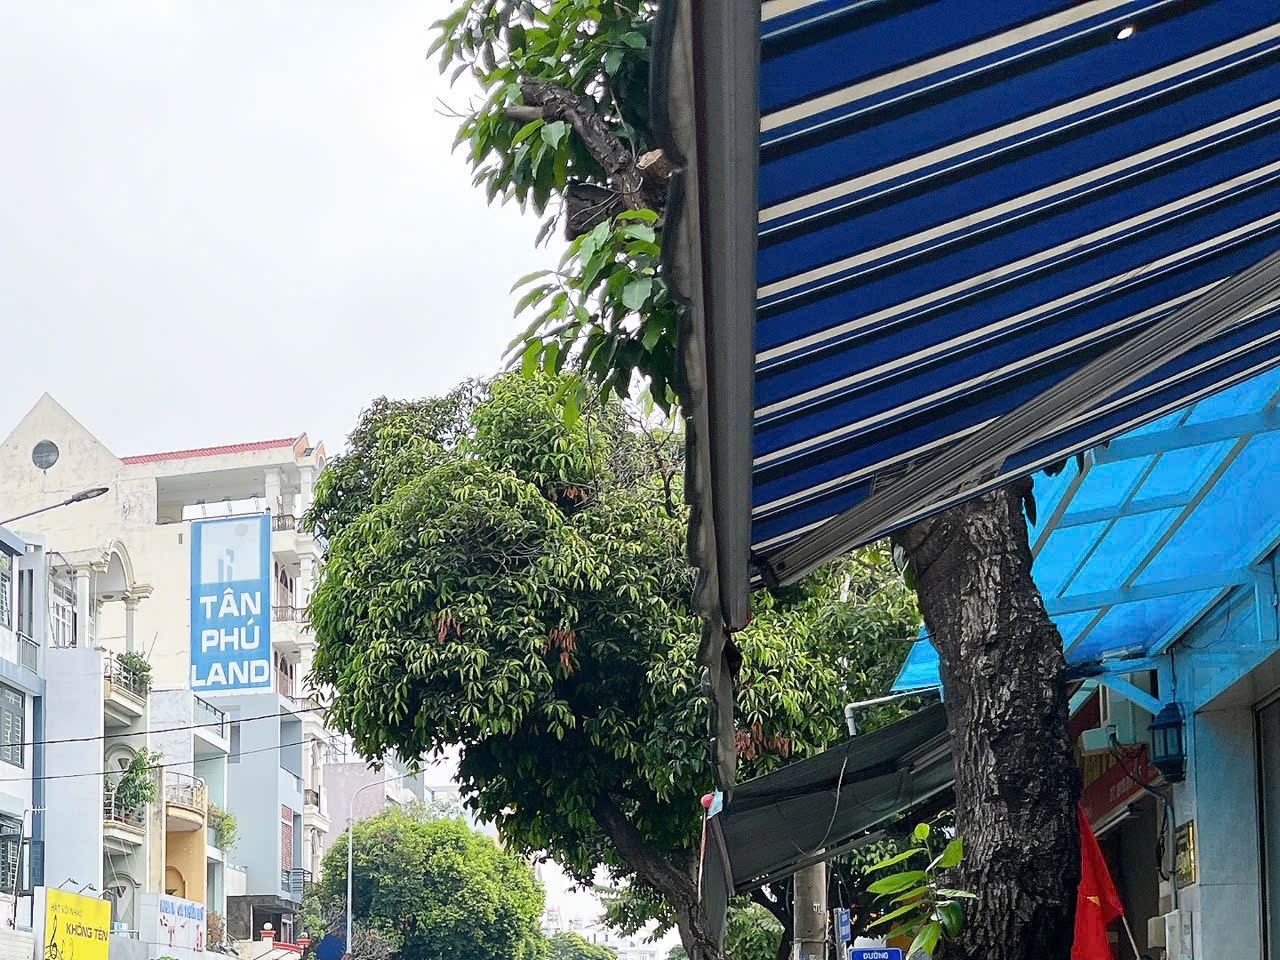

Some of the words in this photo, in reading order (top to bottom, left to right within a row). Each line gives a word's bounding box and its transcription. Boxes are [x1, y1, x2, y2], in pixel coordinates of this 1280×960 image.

[199, 587, 261, 619] TÂN
[201, 617, 260, 653] PHÚ
[191, 659, 270, 688] LAND
